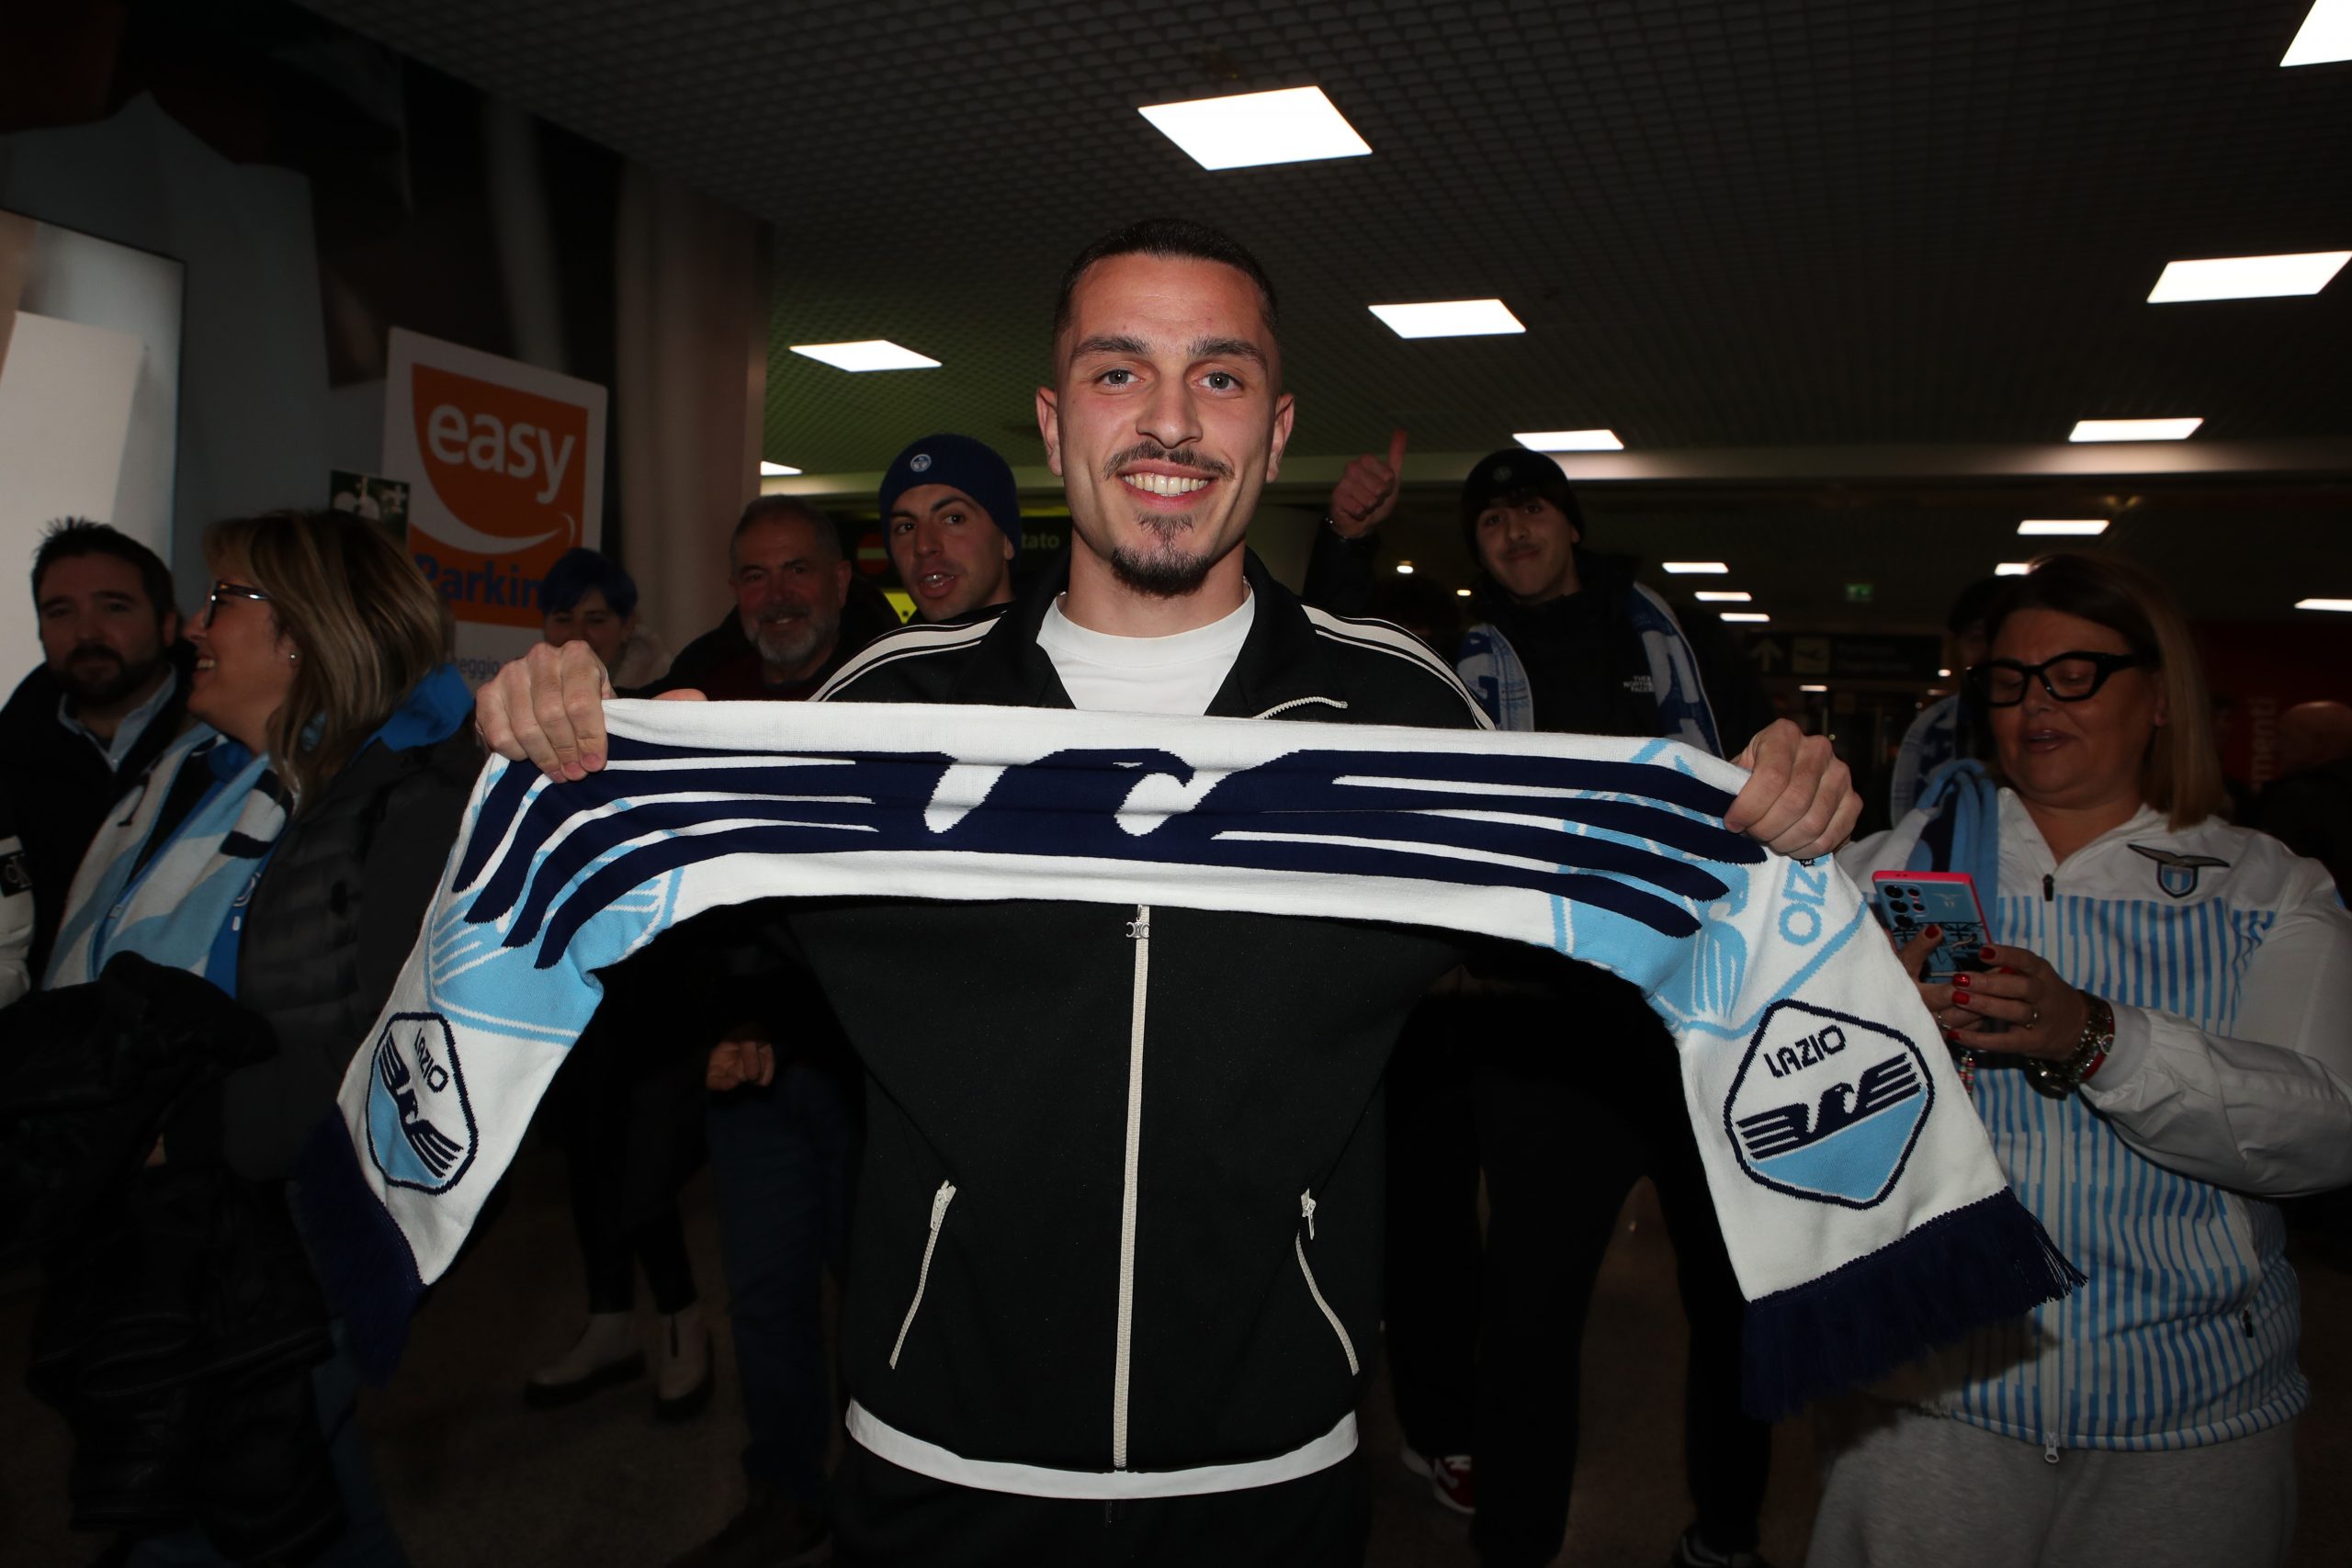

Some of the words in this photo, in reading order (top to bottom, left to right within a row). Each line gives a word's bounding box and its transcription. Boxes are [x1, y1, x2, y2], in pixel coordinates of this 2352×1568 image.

[426, 402, 577, 504] easy
[1020, 532, 1061, 550] tato
[414, 553, 544, 611] Parkin
[459, 657, 503, 681] eggio
[1778, 853, 1830, 946] ZIO
[413, 1028, 448, 1093] LAZIO
[1764, 1024, 1846, 1077] LAZIO
